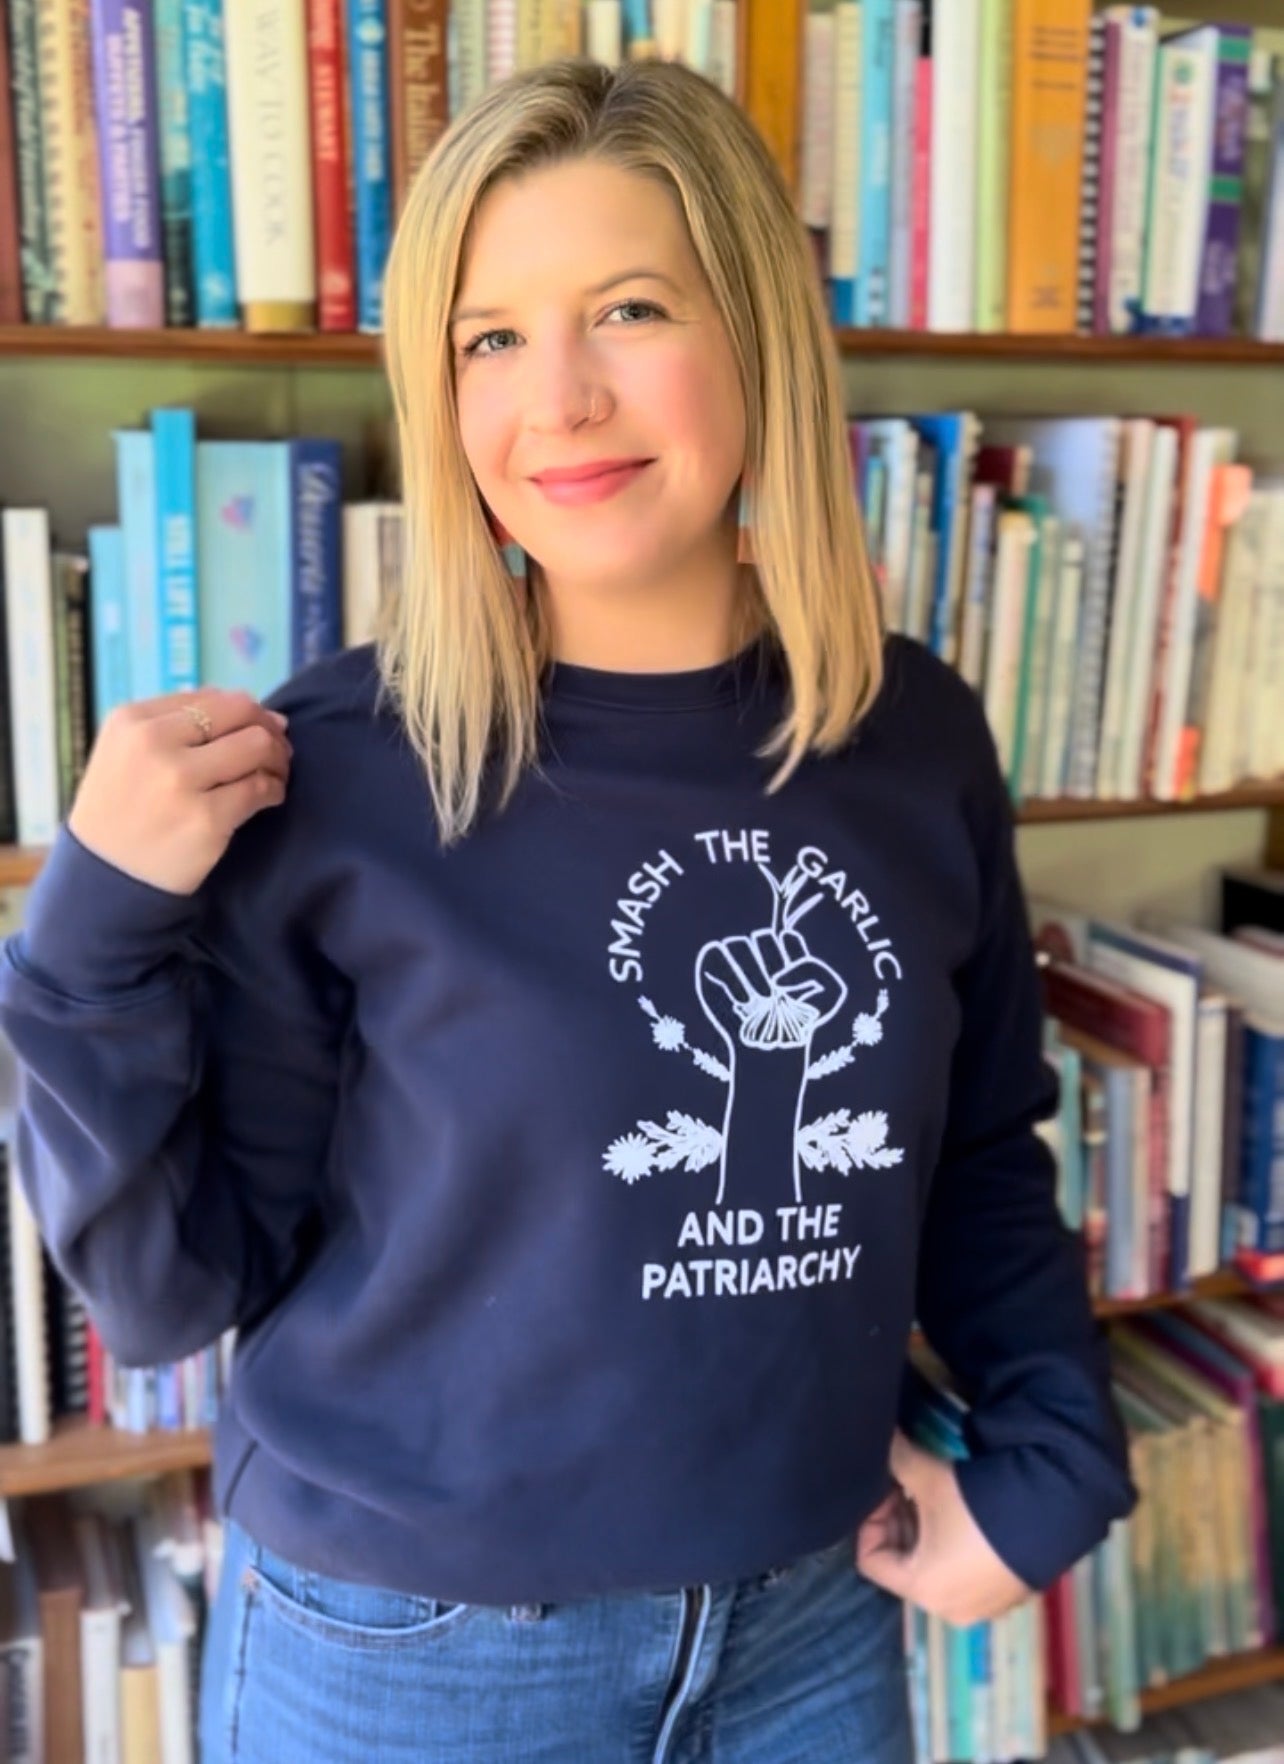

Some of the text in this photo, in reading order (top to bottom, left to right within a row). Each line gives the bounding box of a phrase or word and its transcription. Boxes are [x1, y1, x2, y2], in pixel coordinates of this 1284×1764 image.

[608, 829, 902, 982] SMASH THE GARLIC
[677, 1203, 843, 1248] AND THE
[641, 1244, 862, 1300] PATRIARCHY
